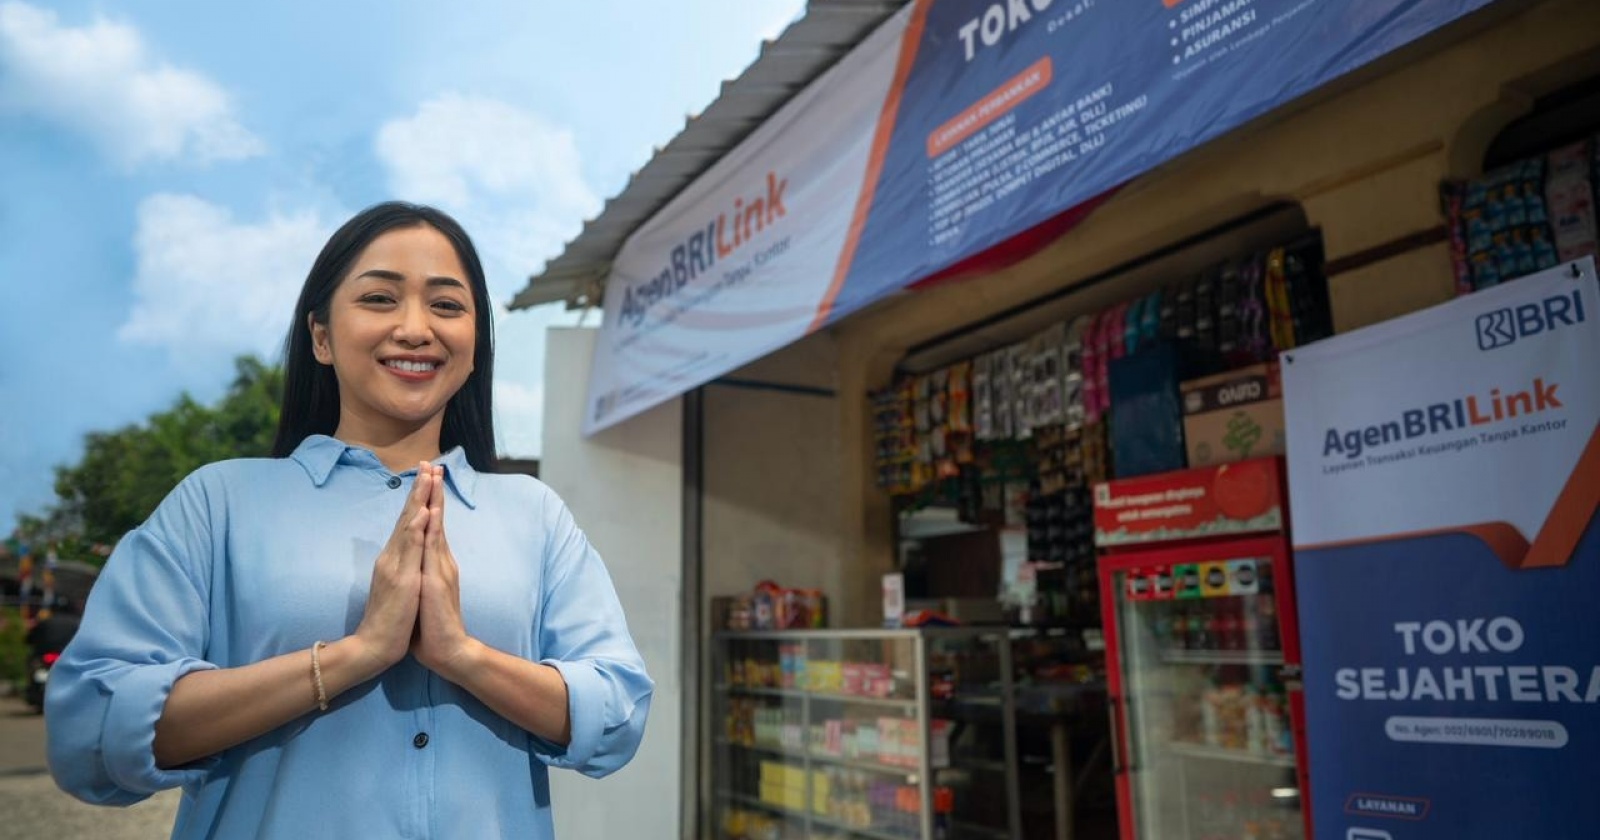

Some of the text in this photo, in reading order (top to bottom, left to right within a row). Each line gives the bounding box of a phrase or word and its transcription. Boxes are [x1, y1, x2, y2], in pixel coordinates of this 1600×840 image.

[958, 0, 1055, 61] TOK
[1182, 0, 1252, 41] PINJAMA
[1184, 8, 1256, 60] ASURANSI
[1517, 289, 1586, 339] BRI
[1322, 377, 1563, 460] AgenBRILink
[1418, 437, 1478, 456] Keuangan
[1480, 430, 1518, 445] Tanpa
[1521, 417, 1568, 435] Kantor
[1394, 616, 1525, 655] TOKO
[1357, 798, 1416, 814] LAYANAN
